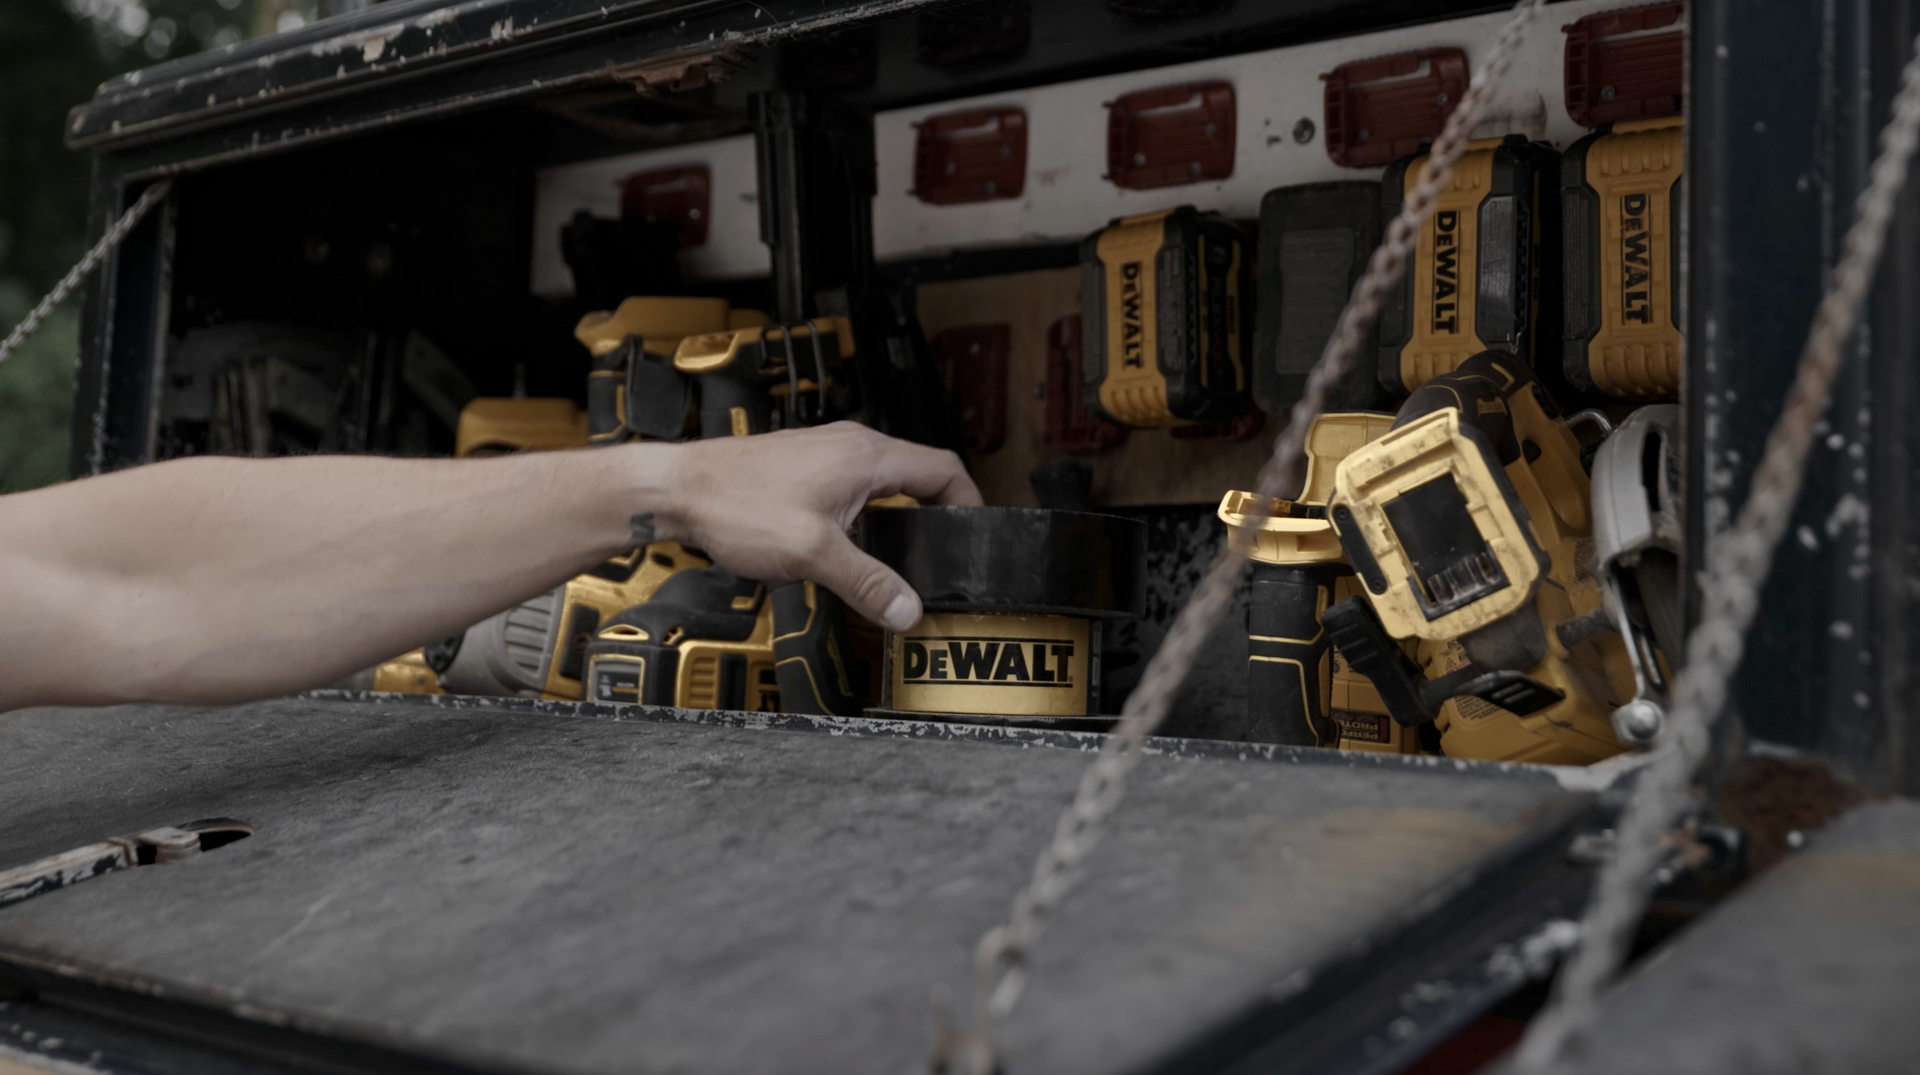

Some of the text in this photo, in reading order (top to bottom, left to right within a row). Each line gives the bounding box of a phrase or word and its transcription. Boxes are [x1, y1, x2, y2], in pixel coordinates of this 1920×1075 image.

[1124, 262, 1141, 368] DEWALT
[1435, 210, 1457, 334] DEWALT
[903, 641, 1074, 683] DEWALT
